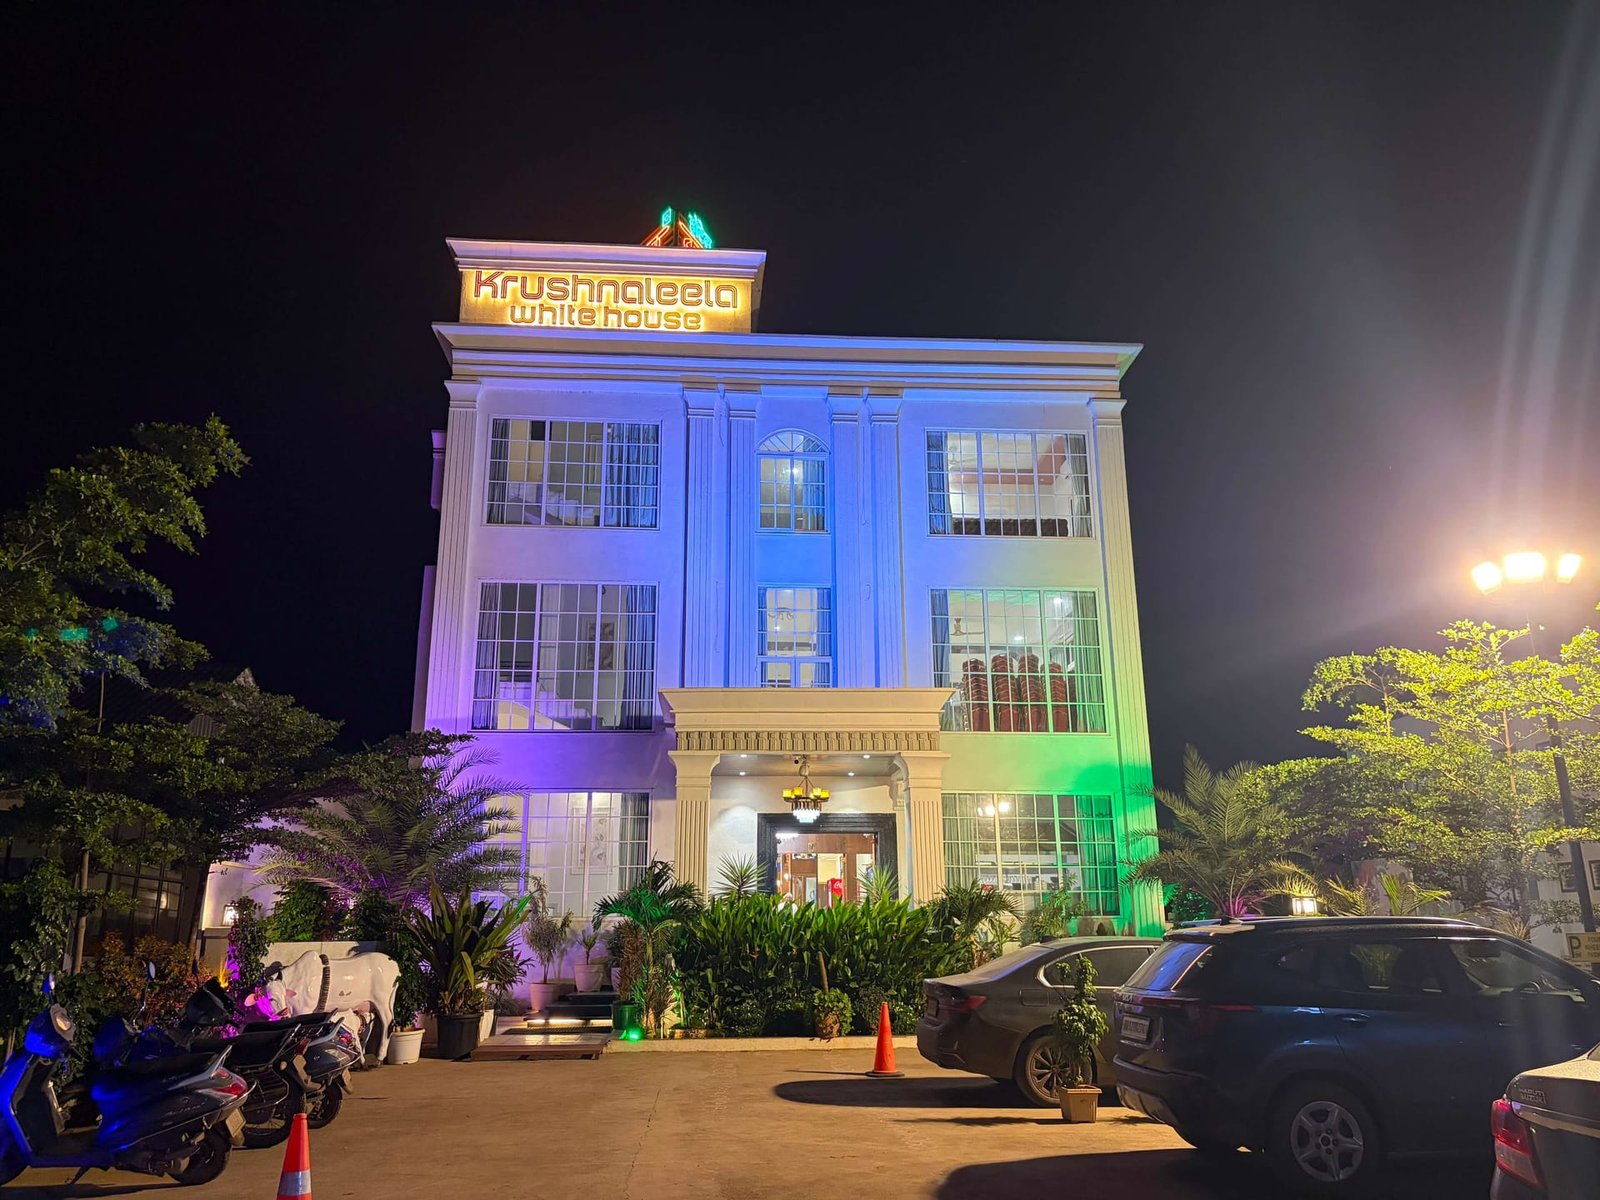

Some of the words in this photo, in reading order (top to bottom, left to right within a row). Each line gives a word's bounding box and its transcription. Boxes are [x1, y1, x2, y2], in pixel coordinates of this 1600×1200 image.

[474, 271, 737, 308] Krushnaleela
[510, 304, 596, 326] white
[603, 305, 701, 330] house
[1568, 935, 1582, 958] P
